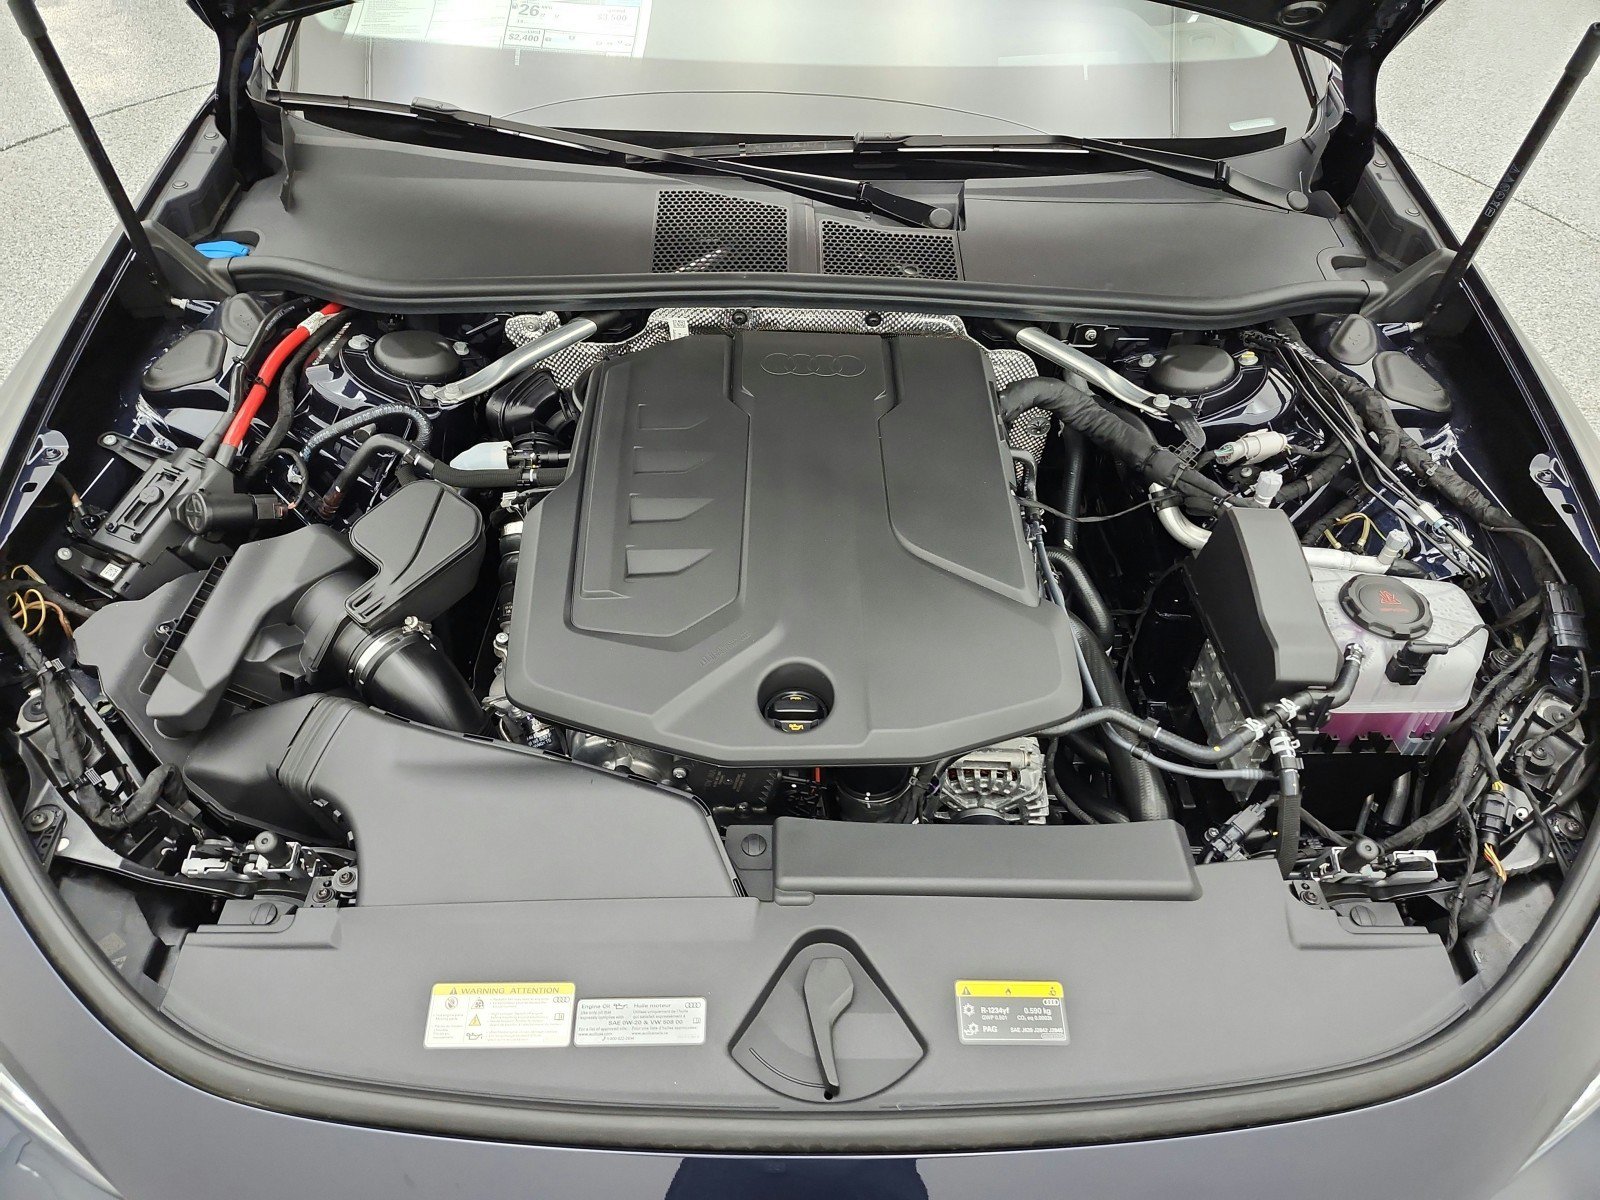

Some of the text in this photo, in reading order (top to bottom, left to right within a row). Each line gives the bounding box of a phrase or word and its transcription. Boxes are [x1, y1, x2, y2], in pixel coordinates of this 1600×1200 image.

[518, 3, 541, 17] 26
[508, 33, 539, 42] $2,400
[461, 986, 560, 995] WARNING ATTENTION
[581, 1003, 601, 1011] Engine
[980, 1006, 1009, 1015] R-1234yf
[1043, 1007, 1051, 1015] kg
[982, 1025, 998, 1033] PAG
